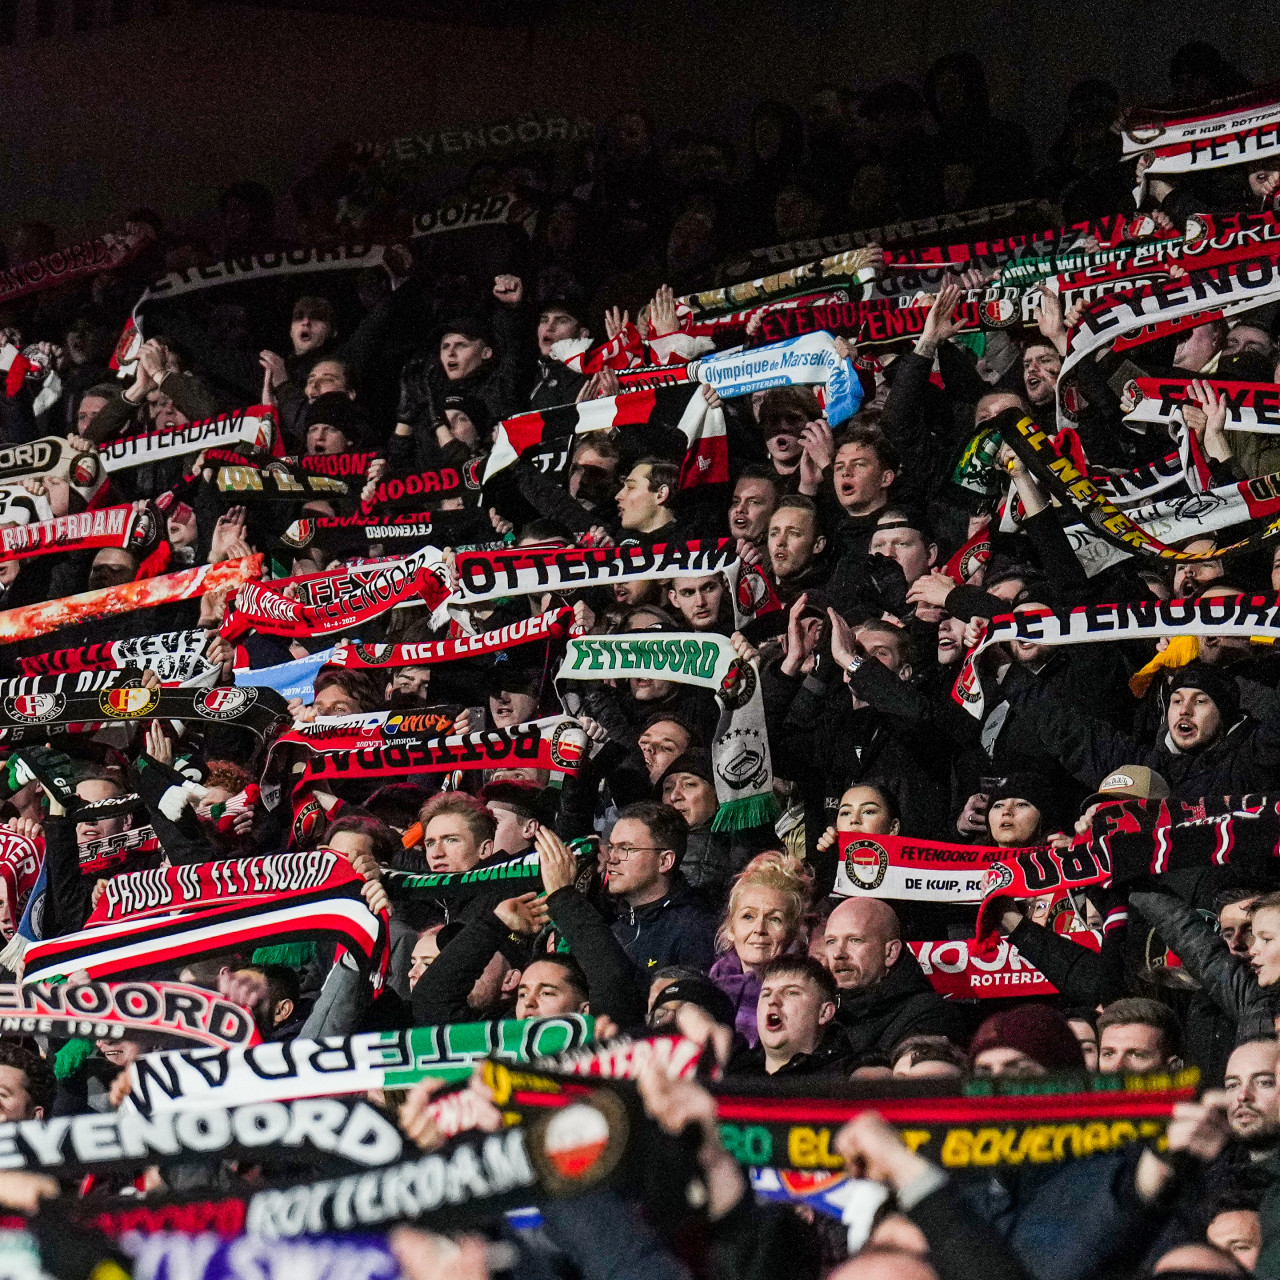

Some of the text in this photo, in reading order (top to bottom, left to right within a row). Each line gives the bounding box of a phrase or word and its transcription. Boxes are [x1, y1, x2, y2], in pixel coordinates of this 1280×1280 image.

[705, 350, 836, 384] Olympique de Marseille
[740, 378, 788, 394] ROTTERDAM
[101, 413, 246, 463] ROTTERDAM
[3, 511, 127, 552] ROTTERDAM
[365, 523, 433, 539] FEYENOORD
[260, 592, 300, 622] PRAHA
[453, 606, 560, 650] LEGIOEN
[571, 636, 717, 677] FEYENOORD
[75, 670, 122, 692] DIE
[101, 701, 157, 719] ROTTERDAM
[901, 844, 977, 863] FEYENOORD
[107, 852, 337, 918] PROUD OF FEYENOORD
[906, 877, 961, 894] DE KUIP,
[59, 1018, 124, 1038] 1908
[246, 1130, 538, 1228] ROTTERDAM
